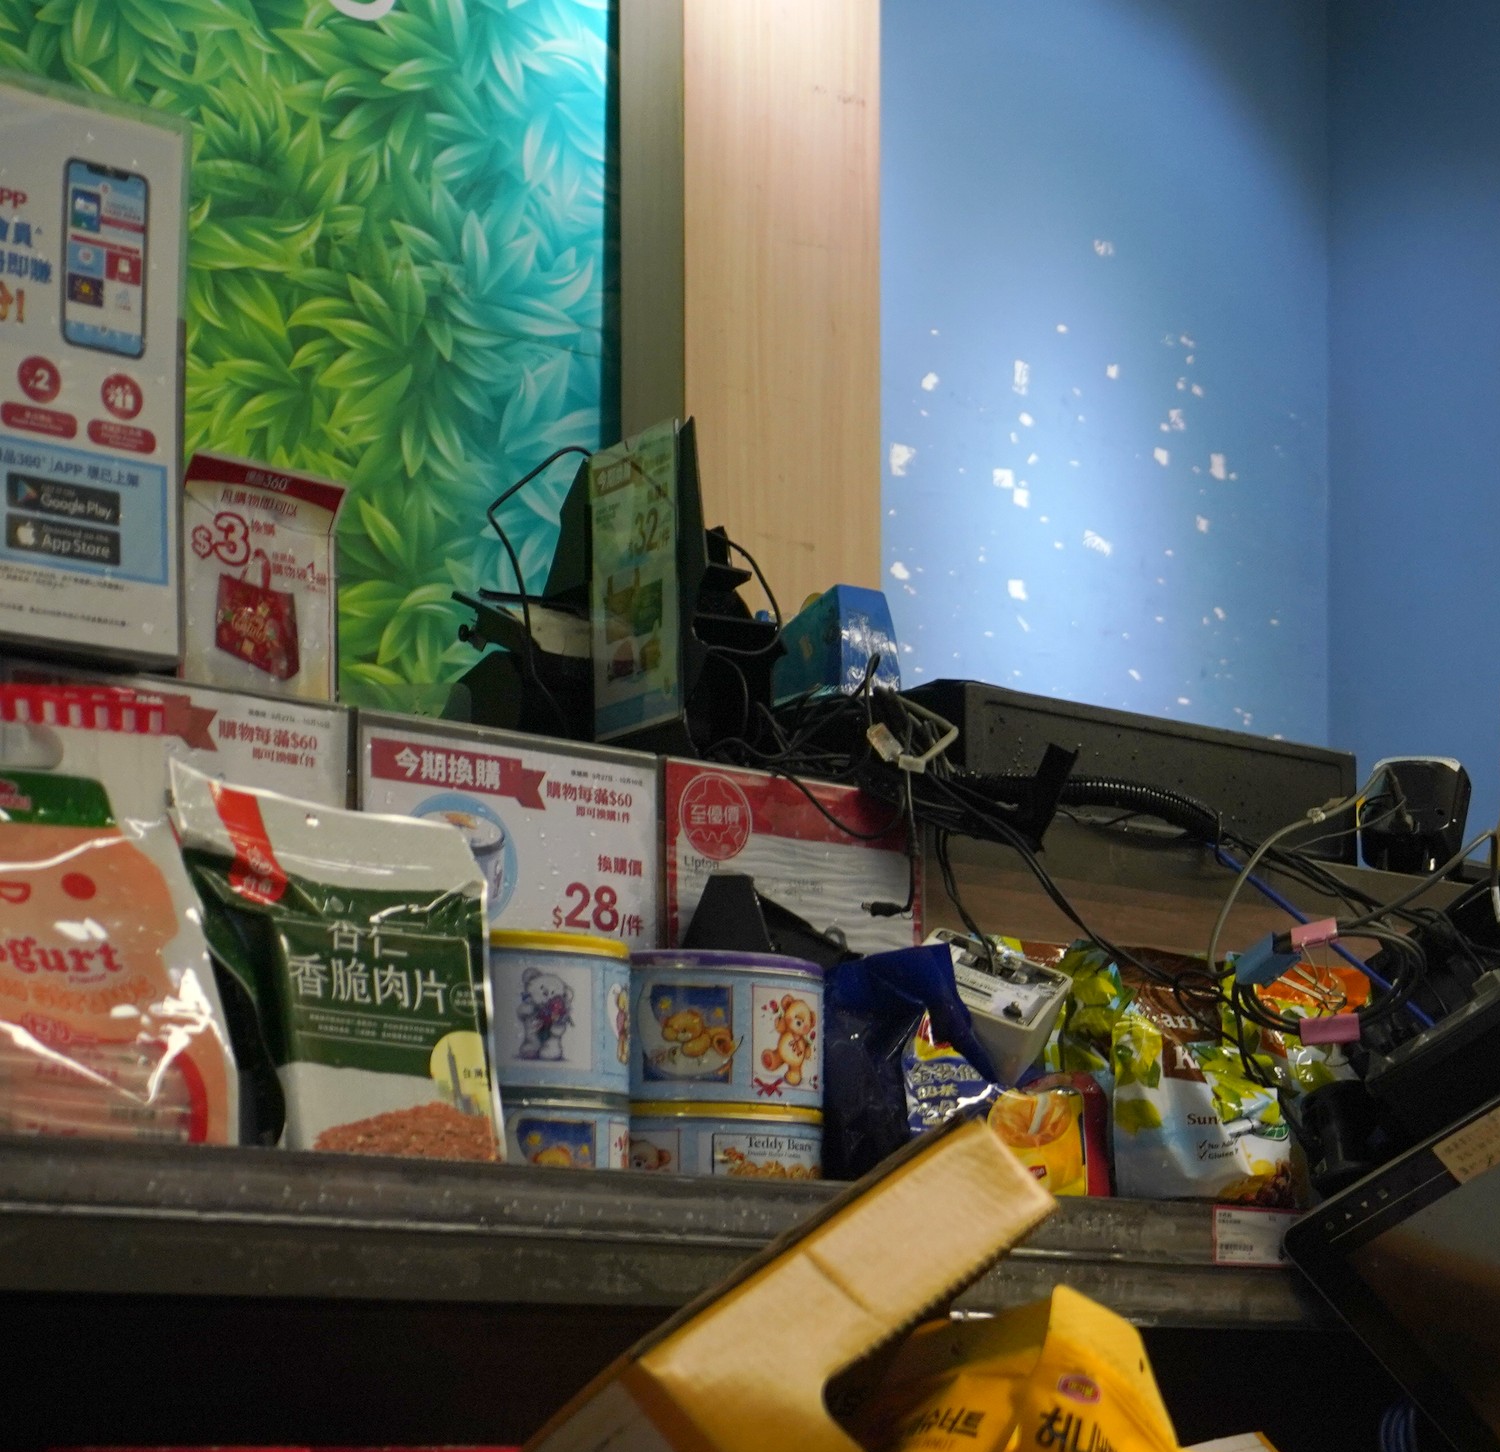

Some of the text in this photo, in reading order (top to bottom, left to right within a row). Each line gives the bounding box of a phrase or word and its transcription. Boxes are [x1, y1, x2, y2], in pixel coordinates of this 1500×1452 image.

[40, 493, 112, 520] Google Play
[42, 535, 110, 558] App Store
[394, 746, 501, 790] 今期換購
[546, 780, 633, 808] 購物每滿$60
[690, 803, 740, 826] 至優價
[597, 853, 643, 878] 換購價
[552, 881, 644, 938] $28/件
[288, 953, 448, 1015] 香脆肉片
[746, 1135, 812, 1153] Teddy Bears
